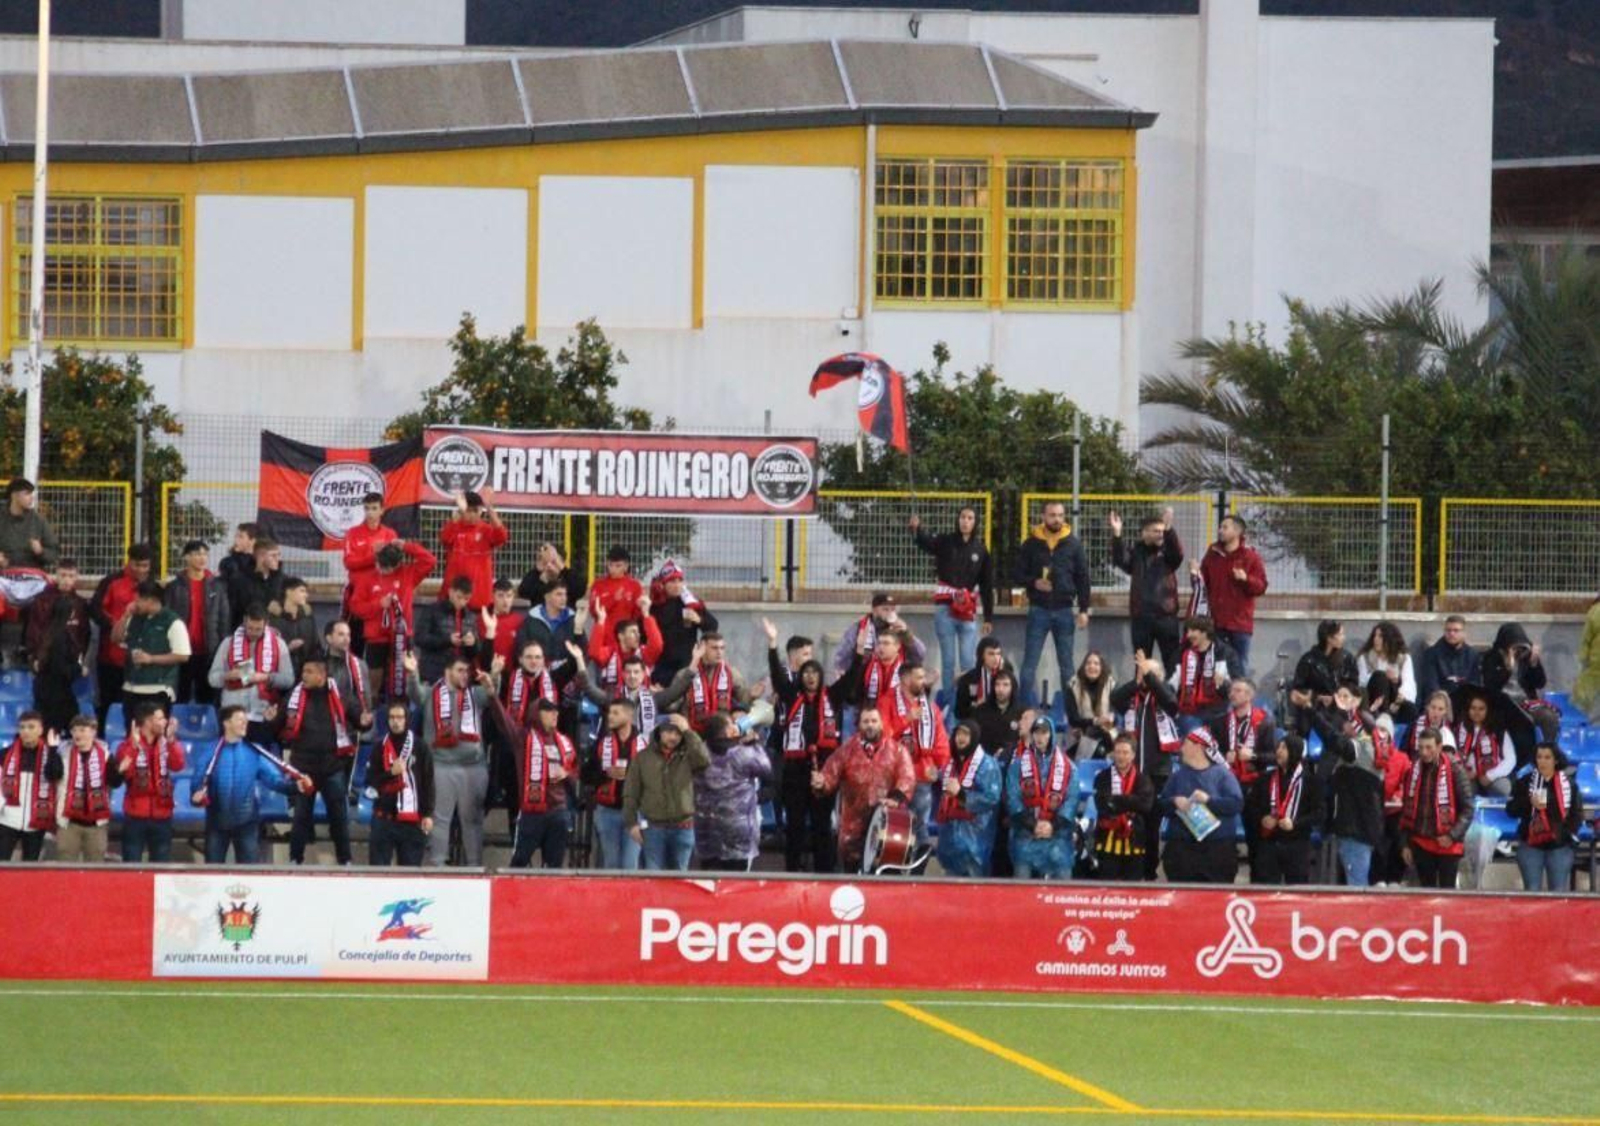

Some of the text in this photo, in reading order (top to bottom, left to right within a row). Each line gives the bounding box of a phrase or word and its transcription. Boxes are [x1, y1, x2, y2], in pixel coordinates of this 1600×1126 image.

[493, 446, 592, 496] FRENTE
[597, 450, 749, 499] ROJINEGRO
[323, 480, 372, 495] FRENTE
[1079, 909, 1100, 920] gran
[640, 885, 888, 975] Peregrin
[1291, 910, 1468, 966] broch
[163, 953, 255, 965] AYUNTAMIENTO
[256, 953, 272, 965] DE
[402, 949, 417, 962] de
[418, 949, 473, 964] Deportes
[1035, 961, 1167, 978] CAMINAMOS JUNTOS
